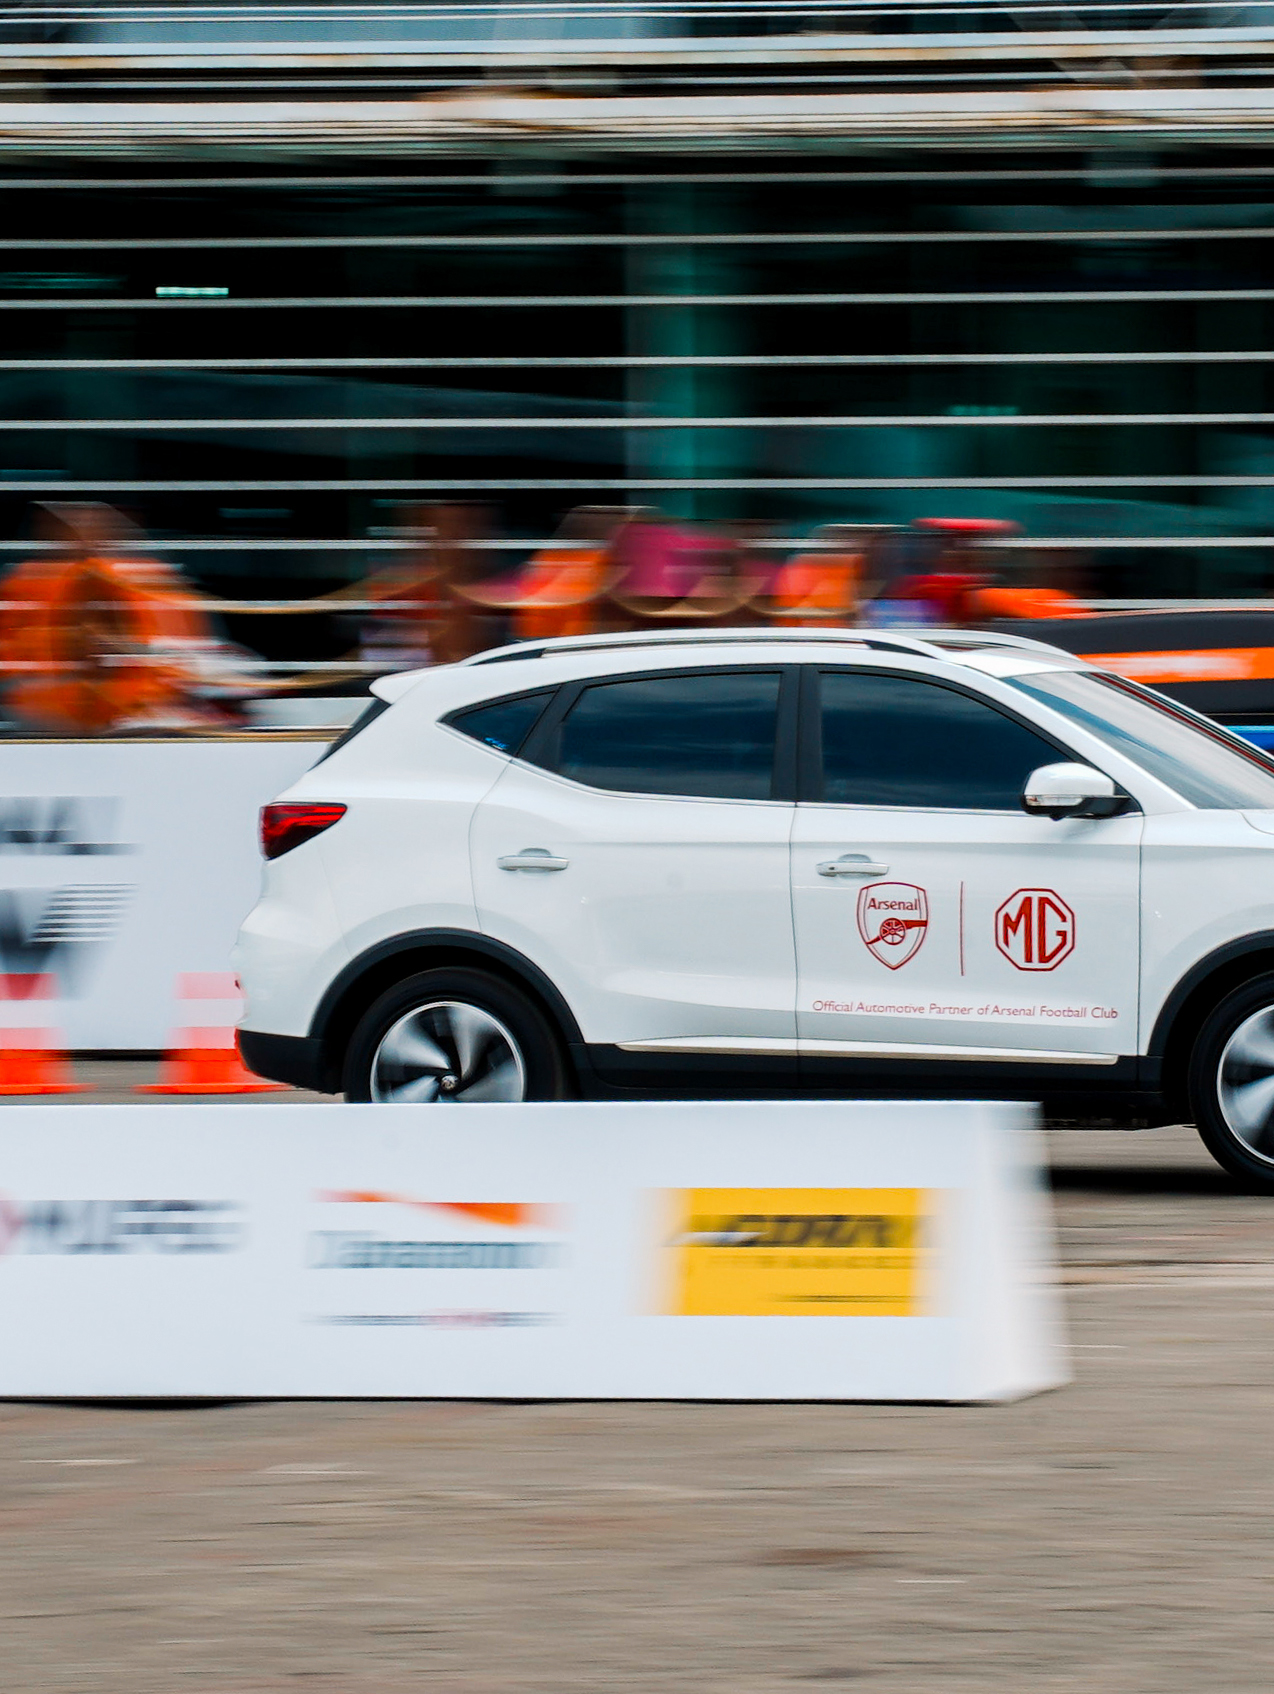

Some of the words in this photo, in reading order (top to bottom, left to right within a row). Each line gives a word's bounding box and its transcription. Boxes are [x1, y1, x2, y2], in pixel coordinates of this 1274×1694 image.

[867, 897, 919, 911] Arsenal
[1003, 896, 1067, 963] MG
[812, 1000, 854, 1012] Official
[855, 1001, 925, 1014] Automotive
[929, 1003, 973, 1015] Partner
[977, 1004, 990, 1015] of
[991, 1005, 1036, 1016] Arsenal
[1040, 1005, 1087, 1018] Football
[1091, 1006, 1118, 1019] Club
